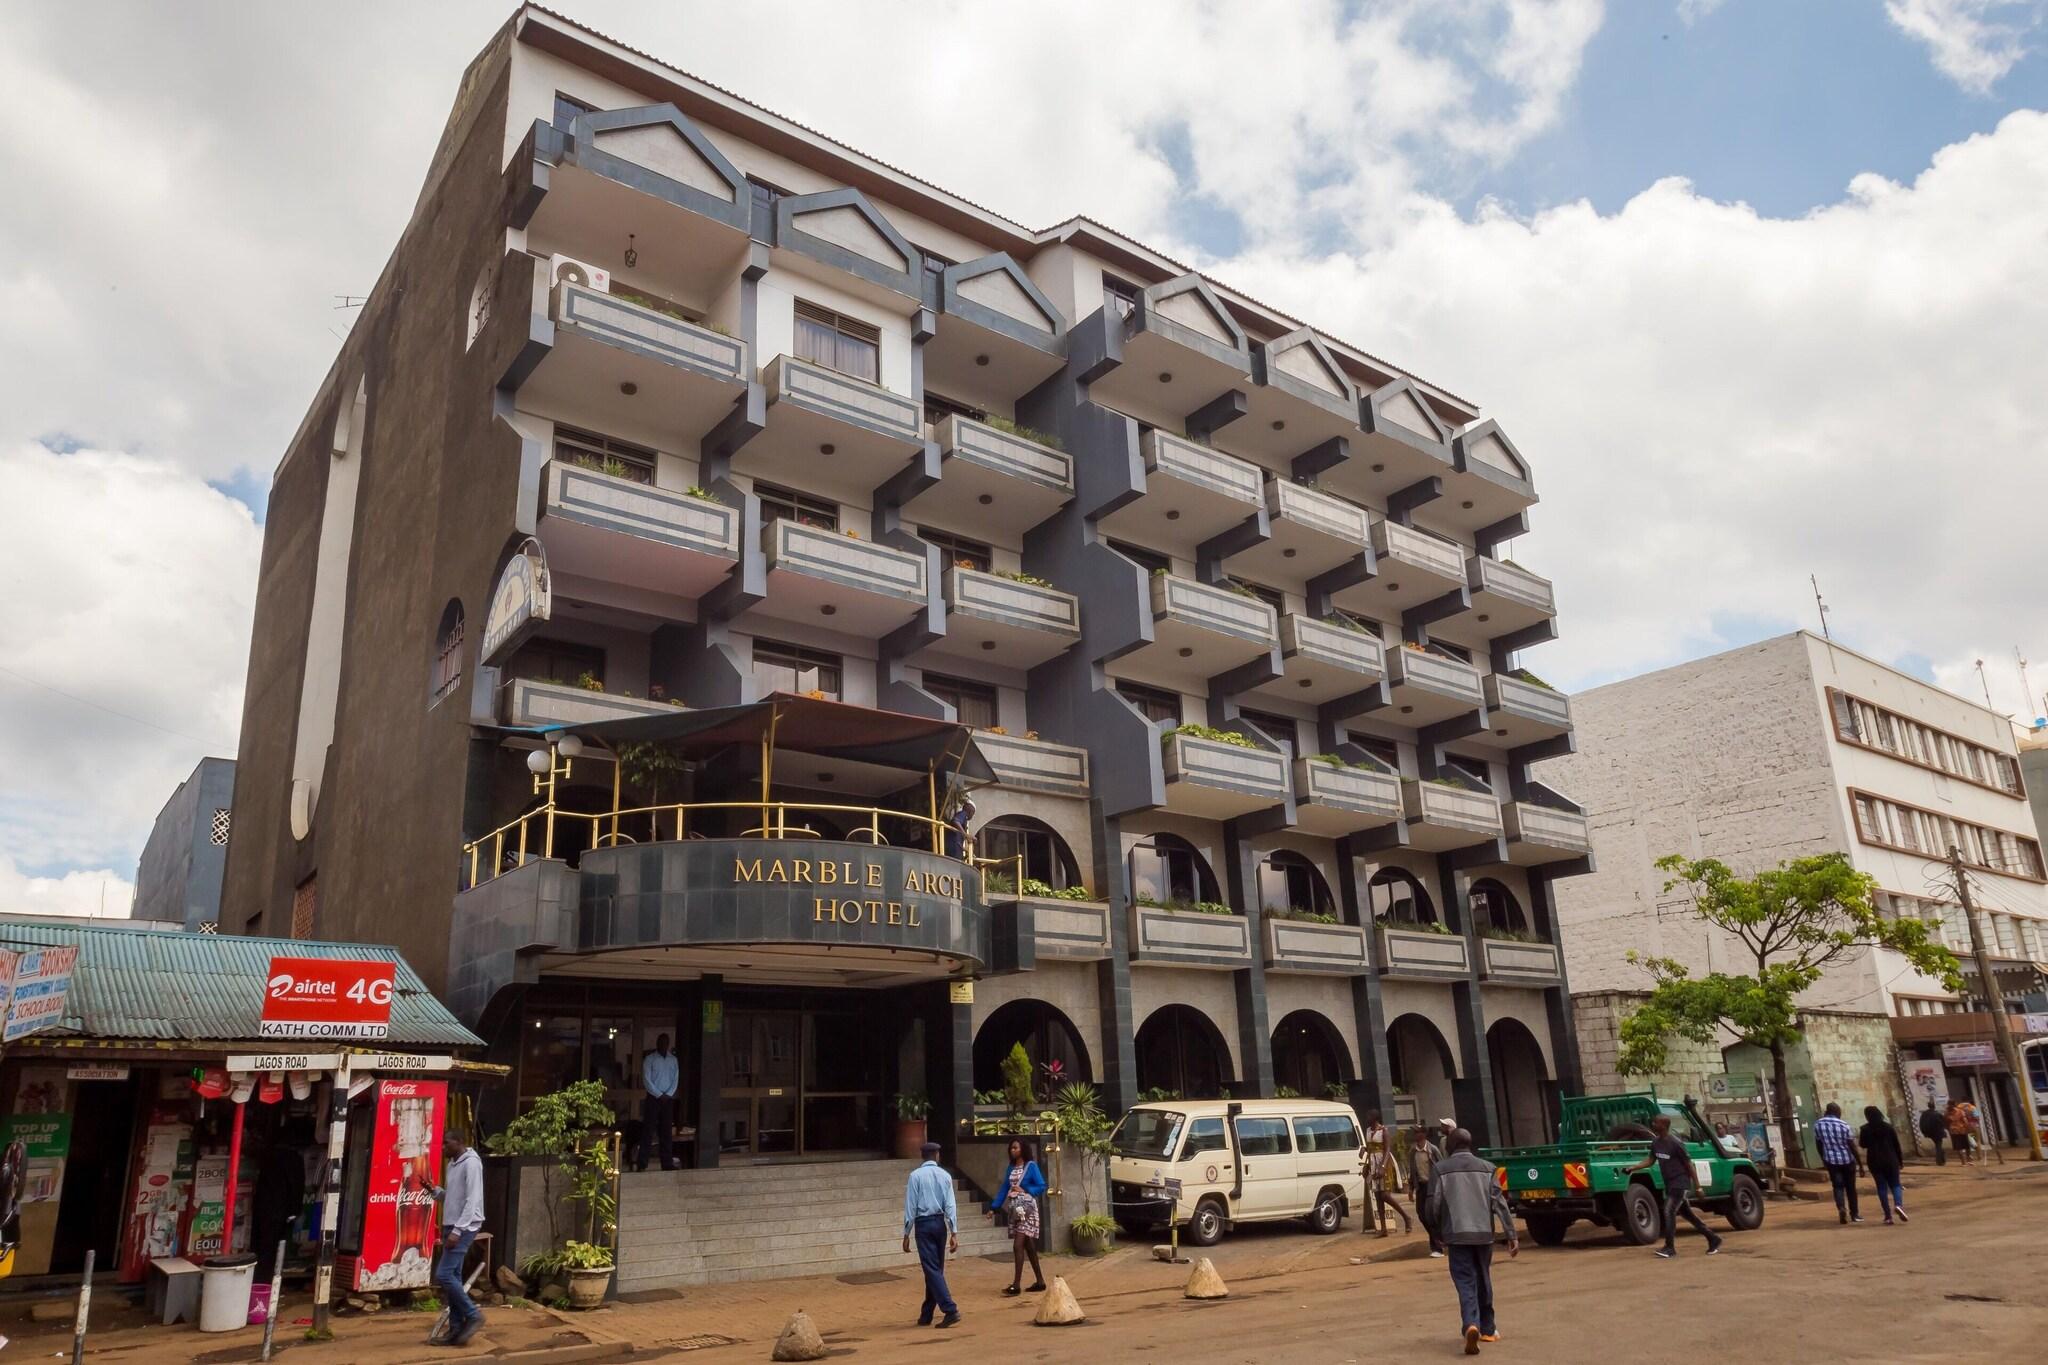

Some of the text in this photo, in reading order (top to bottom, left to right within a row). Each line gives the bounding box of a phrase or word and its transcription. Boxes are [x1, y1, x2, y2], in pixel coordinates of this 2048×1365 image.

[734, 858, 964, 900] MARBLE ARCH
[813, 898, 921, 928] HOTEL
[295, 978, 393, 1005] airtel 4G
[16, 1000, 47, 1019] SCHOOL
[262, 1023, 387, 1037] KATH COMM LTD
[254, 1055, 308, 1070] LAGOS ROAD
[378, 1055, 427, 1069] LAGOS ROAD
[75, 1070, 119, 1078] ASSOCIATION
[12, 1123, 60, 1134] TOP UP
[15, 1134, 53, 1144] HERE
[369, 1192, 397, 1204] drink
[195, 1238, 221, 1250] EQUI
